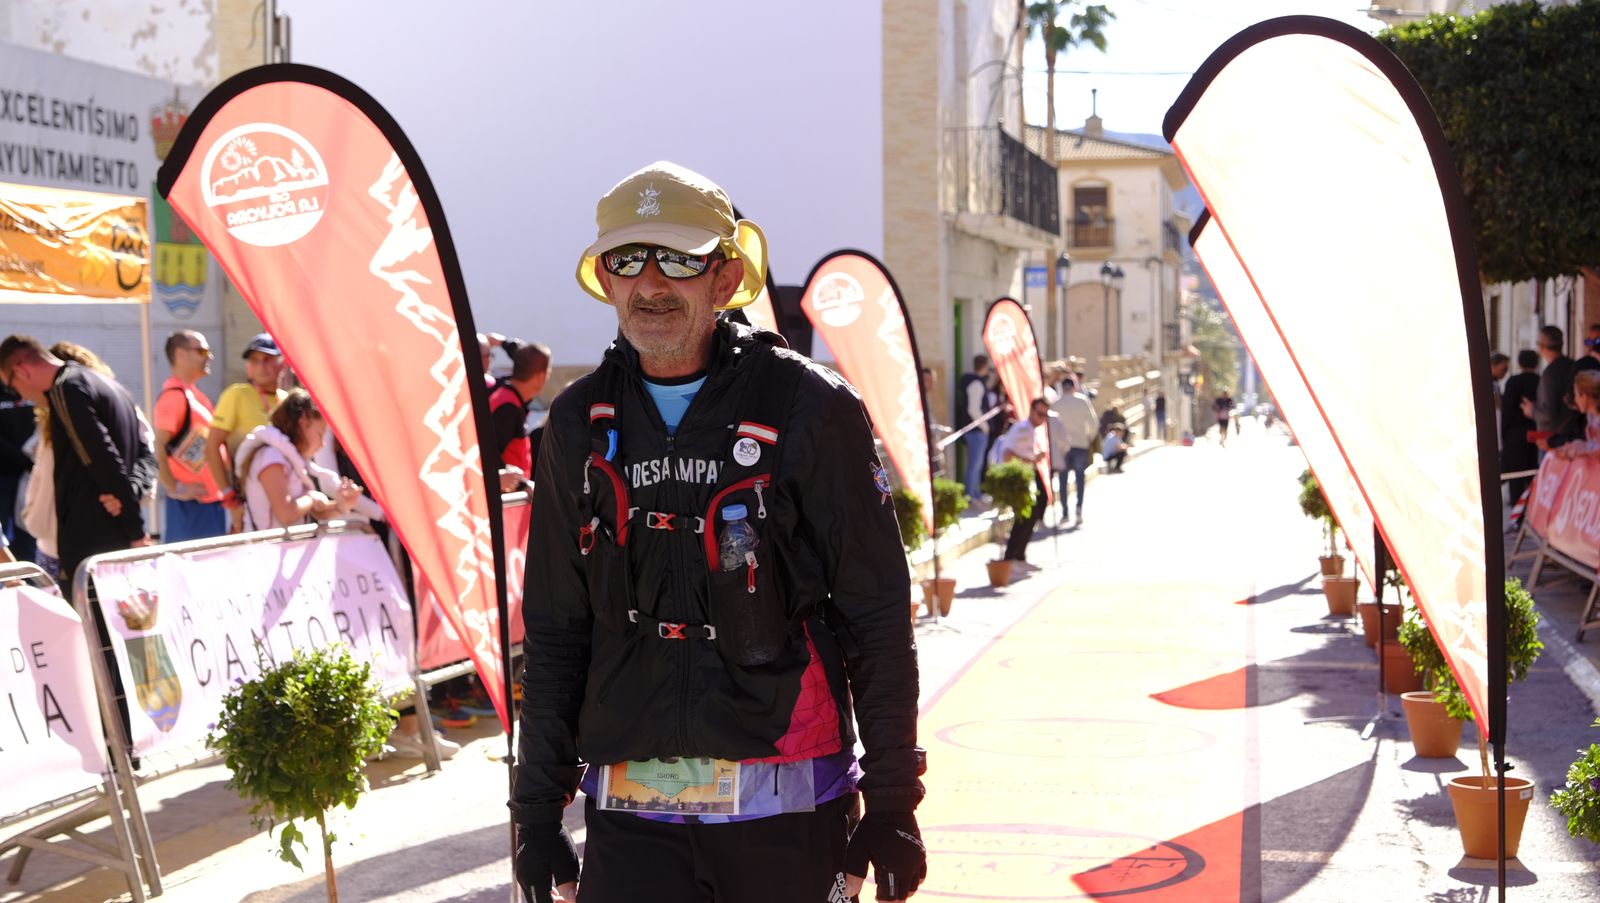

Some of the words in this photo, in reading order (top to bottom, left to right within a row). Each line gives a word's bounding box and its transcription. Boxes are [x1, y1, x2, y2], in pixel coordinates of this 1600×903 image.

[356, 572, 385, 595] DE
[10, 641, 48, 674] DE
[190, 602, 398, 687] CANTORIA
[0, 683, 73, 751] IA
